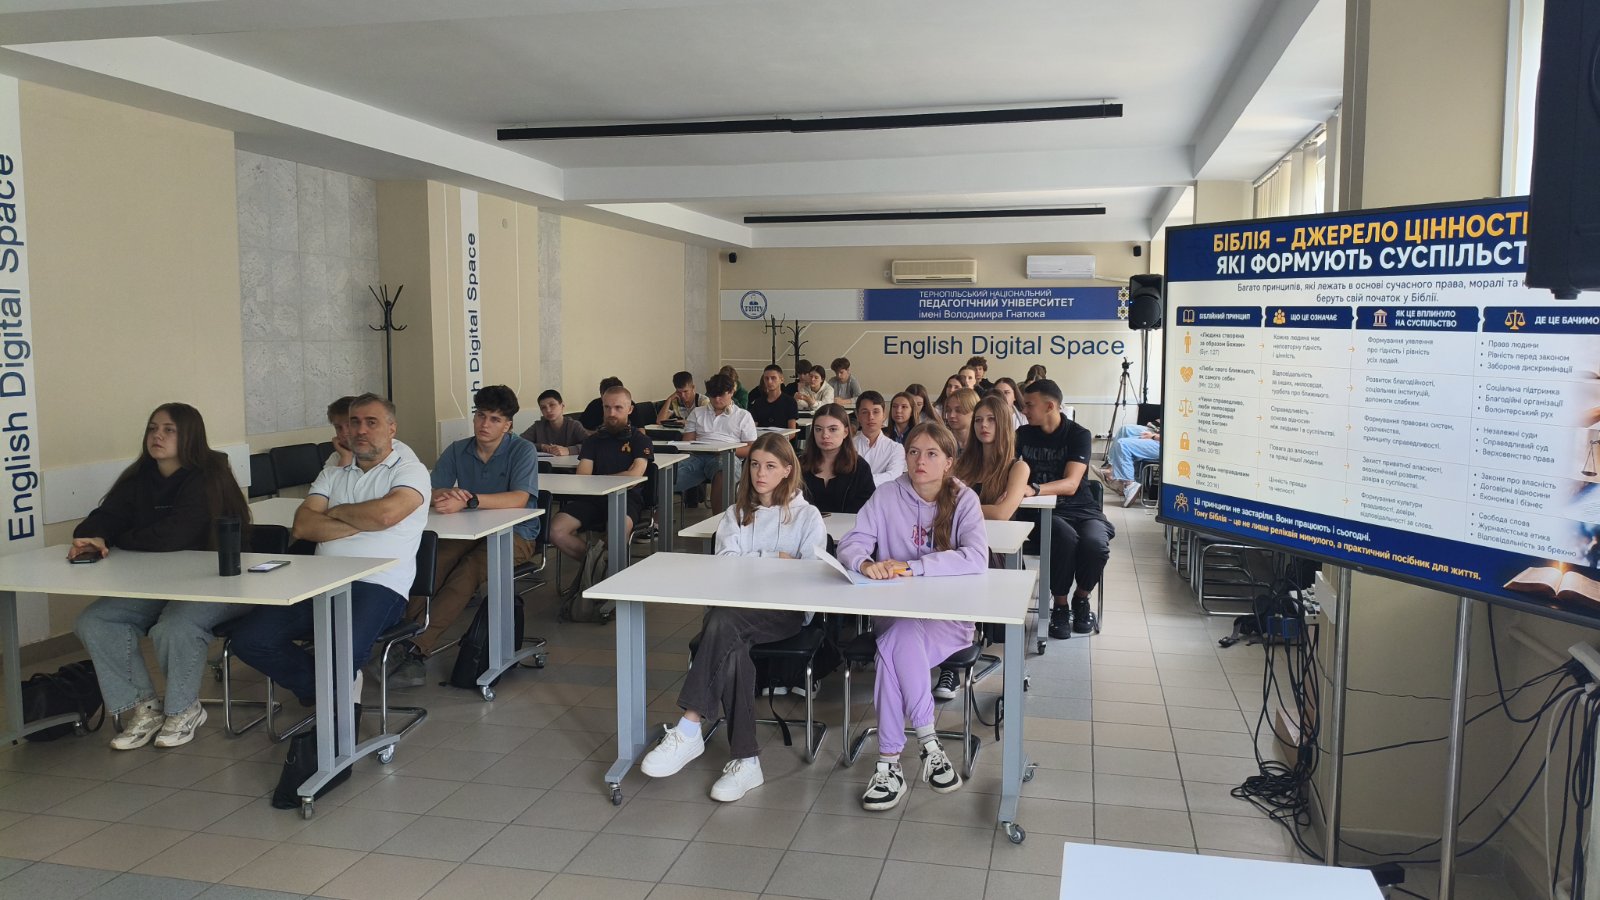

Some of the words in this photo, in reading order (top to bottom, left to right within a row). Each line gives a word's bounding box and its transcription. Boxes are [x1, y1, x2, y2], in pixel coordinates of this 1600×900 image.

[0, 154, 24, 273] Space
[1213, 230, 1270, 252] БІБЛІЯ
[1291, 220, 1399, 250] ДЖЕРЕЛО
[1216, 255, 1245, 274] ЯКІ
[1250, 249, 1372, 274] ФОРМУЮТЬ
[1379, 241, 1527, 269] СУСПІЛЬСТ
[467, 233, 478, 301] Space
[1237, 284, 1260, 292] Багато
[1262, 283, 1302, 292] принципів,
[1305, 281, 1316, 290] які
[1356, 280, 1383, 289] основі
[1386, 281, 1432, 291] сучасного
[1436, 280, 1466, 290] права,
[1469, 277, 1504, 291] моралі
[1507, 279, 1518, 287] та
[920, 290, 987, 298] ТЕРНОПІЛЬСЬКИЙ
[990, 289, 1052, 297] НАЦІОНАЛЬНИЙ
[1317, 293, 1344, 302] беруть
[1346, 293, 1363, 302] свій
[1366, 294, 1400, 302] початок
[1412, 293, 1439, 302] Біблії.
[919, 297, 998, 308] ПЕДАГОГІЧНИЙ
[1001, 298, 1074, 307] УНІВЕРСИТЕТ
[944, 310, 1003, 320] Володимира
[1006, 309, 1045, 318] Гнатюка
[1535, 317, 1546, 325] ДЕ
[1549, 317, 1558, 325] ЦЕ
[1562, 317, 1599, 325] БАЧИМО
[0, 288, 31, 397] Digital
[468, 310, 481, 372] Digital
[884, 336, 963, 359] English
[972, 336, 1041, 359] Digital
[1050, 335, 1125, 359] Space
[1488, 340, 1509, 348] Права
[1488, 351, 1514, 359] Рівність
[1488, 362, 1520, 371] Заборона
[1522, 365, 1573, 373] дискримінації
[1486, 384, 1520, 392] Соціальна
[1523, 388, 1560, 397] підтримка
[1486, 395, 1521, 403] Благодійні
[1524, 397, 1563, 407] організації
[1485, 405, 1538, 416] Волонтерський
[1541, 411, 1553, 419] рух
[1484, 427, 1519, 437] Незалежні
[1521, 432, 1538, 440] суди
[1483, 438, 1534, 449] Справедливий
[1536, 444, 1549, 452] суд
[1482, 449, 1531, 461] Верховенство
[1533, 456, 1555, 464] права
[2, 412, 38, 541] English
[1481, 473, 1505, 482] Закони
[1507, 477, 1520, 485] про
[1522, 480, 1556, 489] власність
[1480, 483, 1512, 493] Договірні
[1514, 488, 1550, 499] відносини
[1480, 493, 1514, 505] Економіка
[1520, 499, 1543, 509] бізнес
[1194, 497, 1201, 506] Ці
[1202, 500, 1231, 512] принципи
[1242, 508, 1274, 521] застаріли.
[1276, 514, 1293, 524] Вони
[1294, 518, 1331, 533] працюють
[1332, 525, 1335, 533] і
[1337, 528, 1370, 541] сьогодні.
[1479, 512, 1507, 524] Свобода
[1510, 519, 1530, 527] слова
[1478, 523, 1528, 538] Журналістська
[1530, 533, 1551, 541] етика
[1194, 509, 1207, 520] Тому
[1209, 511, 1227, 523] Біблія
[1233, 519, 1241, 527] це
[1242, 520, 1250, 528] не
[1251, 522, 1269, 532] лише
[1270, 527, 1298, 539] реліквія
[1299, 533, 1335, 548] минулого,
[1343, 544, 1390, 559] практичний
[1392, 555, 1430, 569] посібник
[1432, 563, 1448, 572] для
[1450, 566, 1481, 580] життя.
[1477, 532, 1535, 549] Відповідальність
[1547, 546, 1576, 557] брехню
